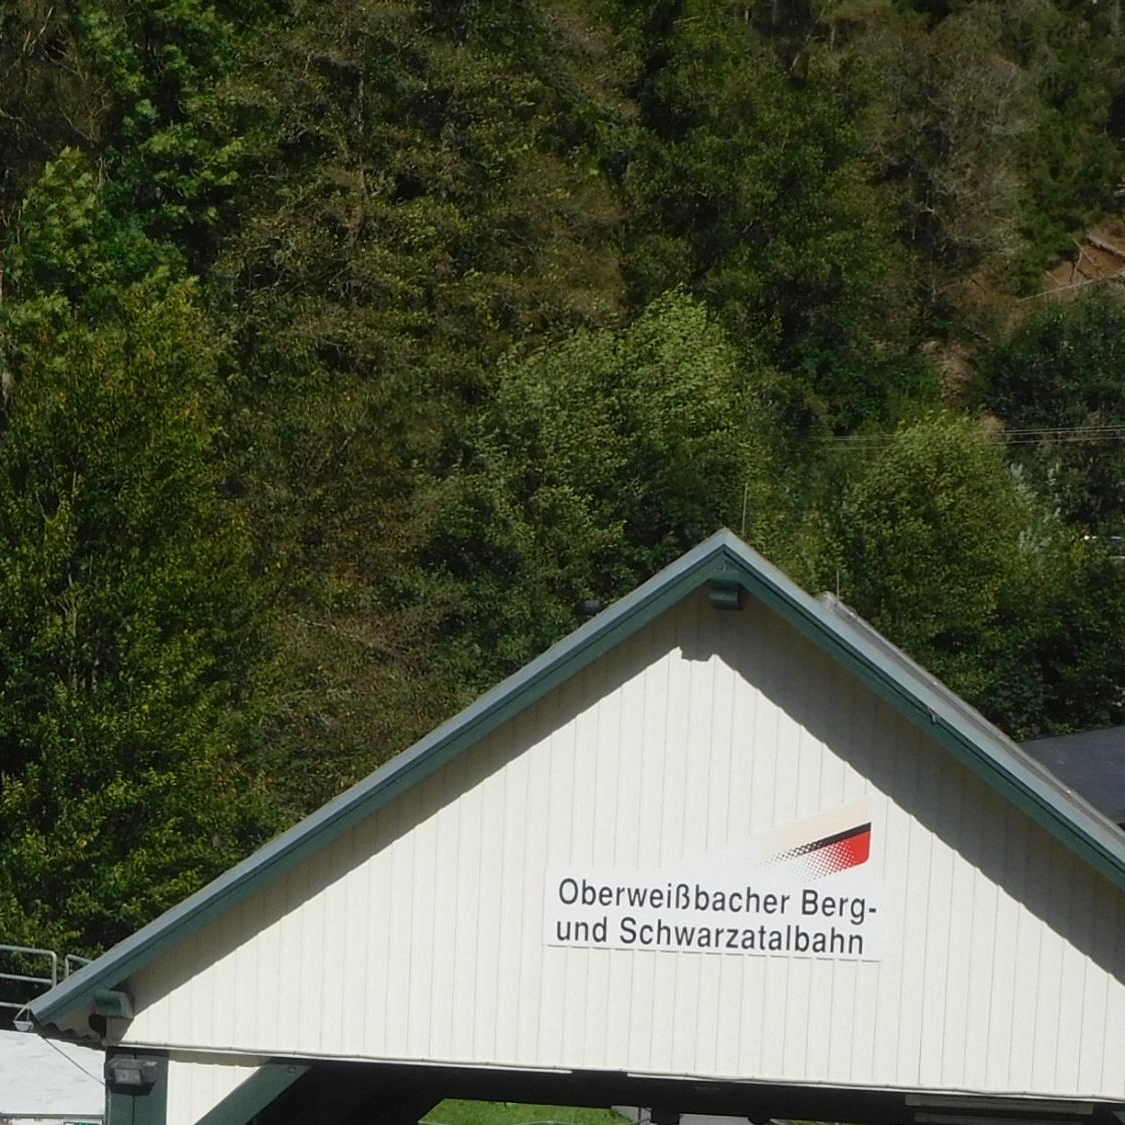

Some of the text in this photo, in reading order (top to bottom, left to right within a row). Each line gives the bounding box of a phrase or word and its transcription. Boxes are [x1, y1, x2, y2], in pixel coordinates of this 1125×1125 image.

[558, 878, 877, 925] Oberweißbacher Berg-
[556, 917, 864, 954] und Schwarzatalbahn
